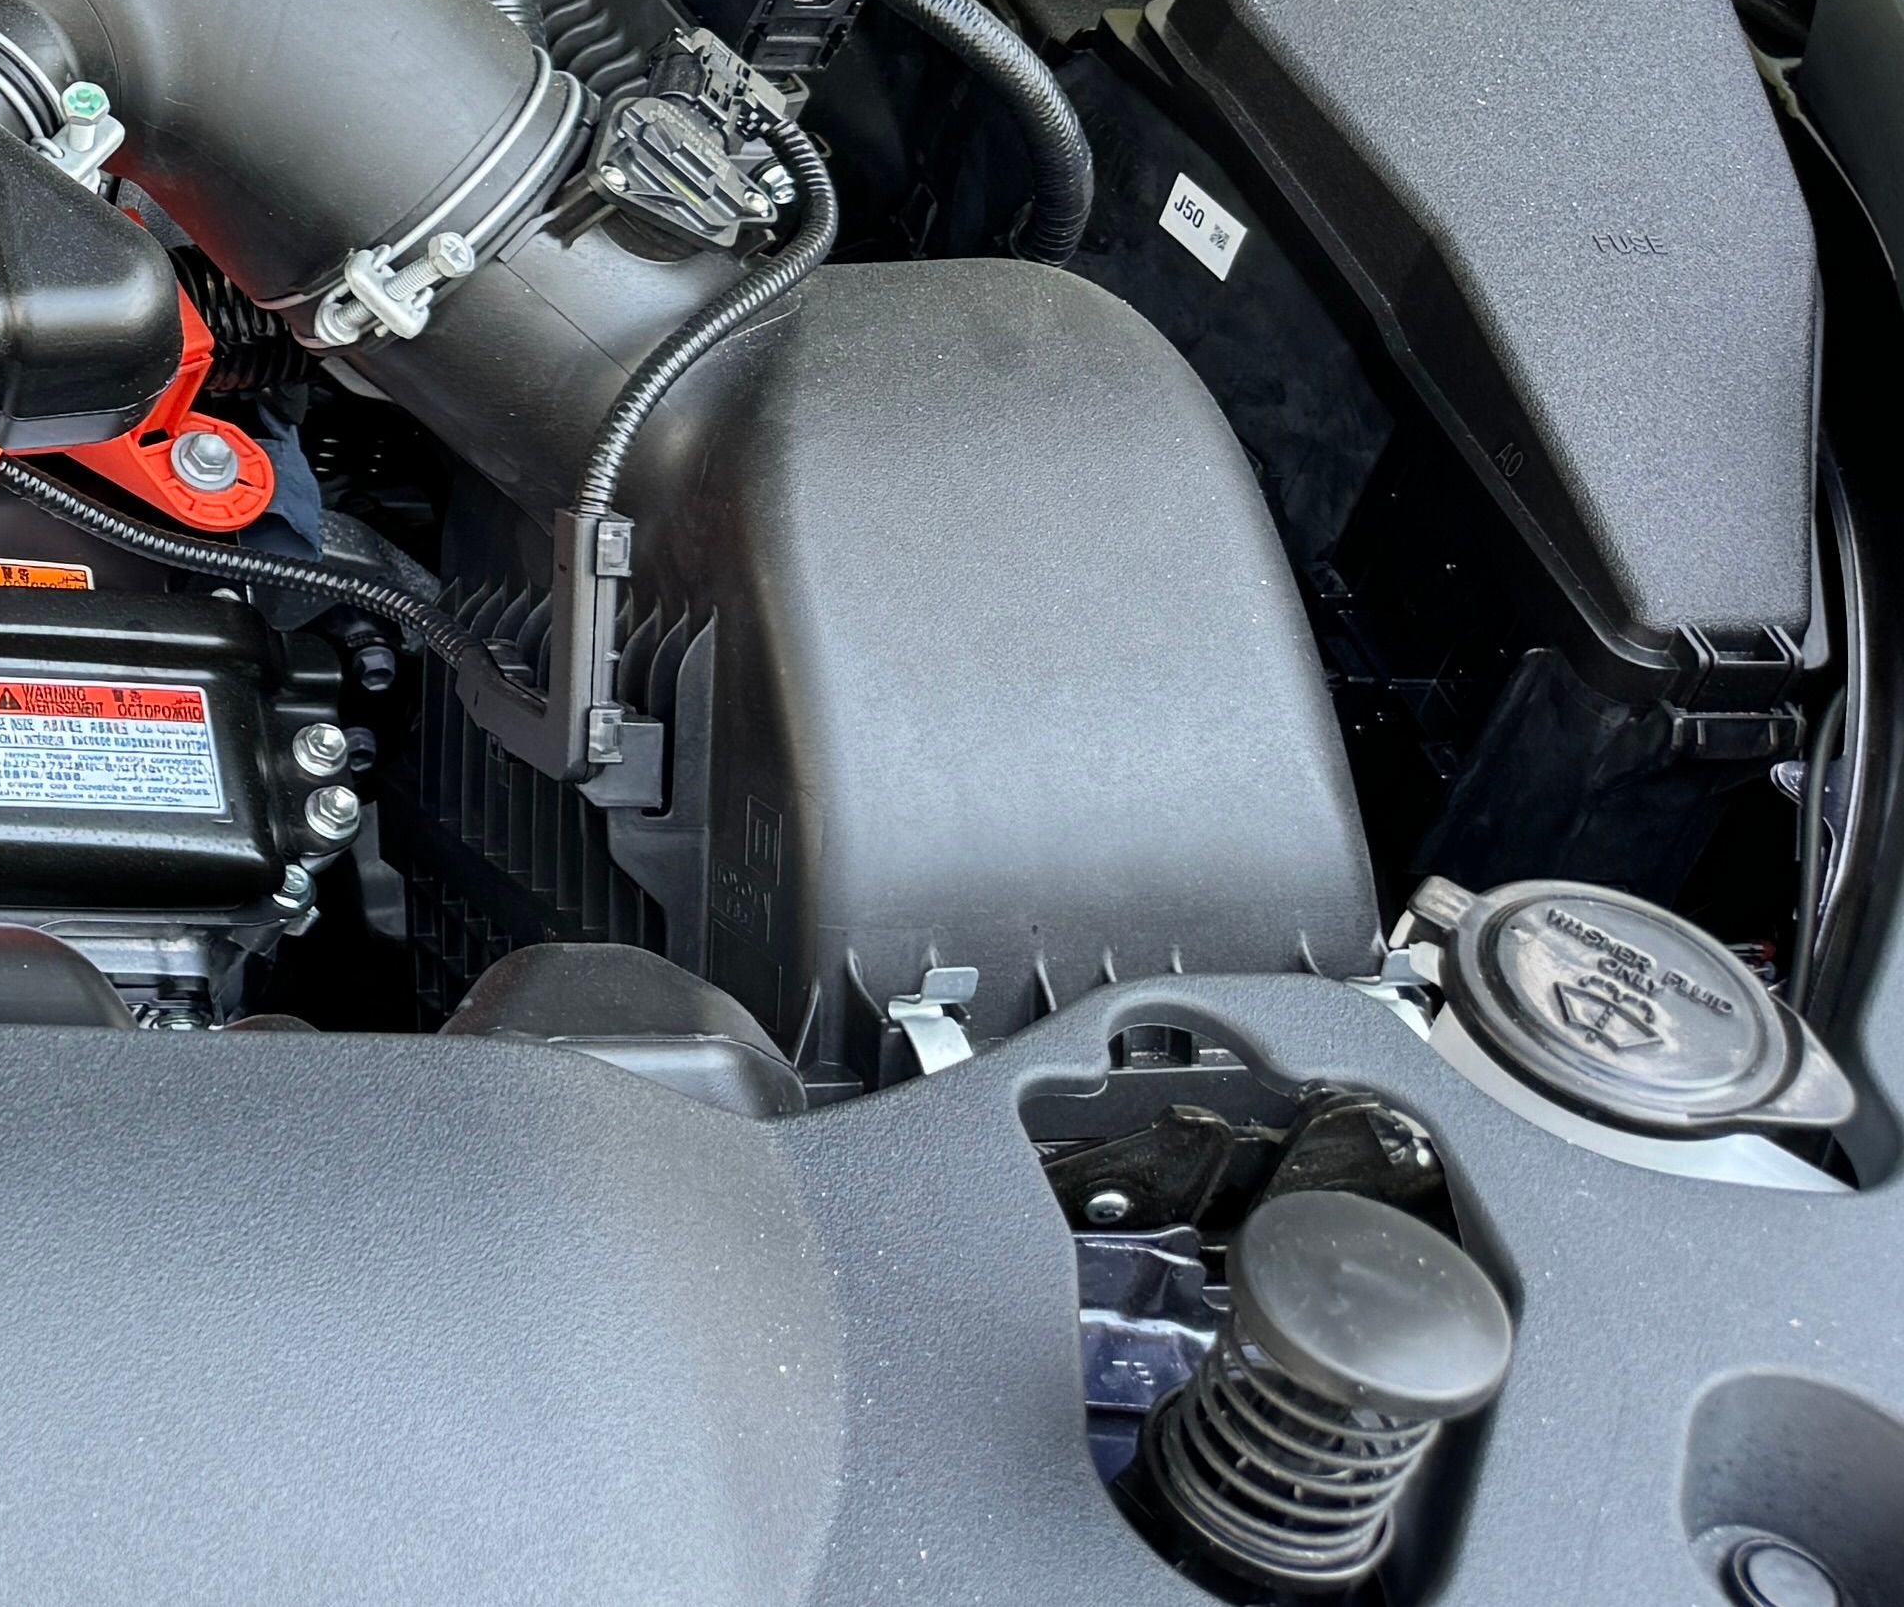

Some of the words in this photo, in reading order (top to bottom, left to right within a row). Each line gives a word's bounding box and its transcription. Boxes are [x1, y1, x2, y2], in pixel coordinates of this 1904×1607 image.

[1174, 194, 1205, 228] J50
[1592, 233, 1669, 255] FUSE
[21, 684, 87, 702] WARNING
[1547, 908, 1656, 975] WASHER
